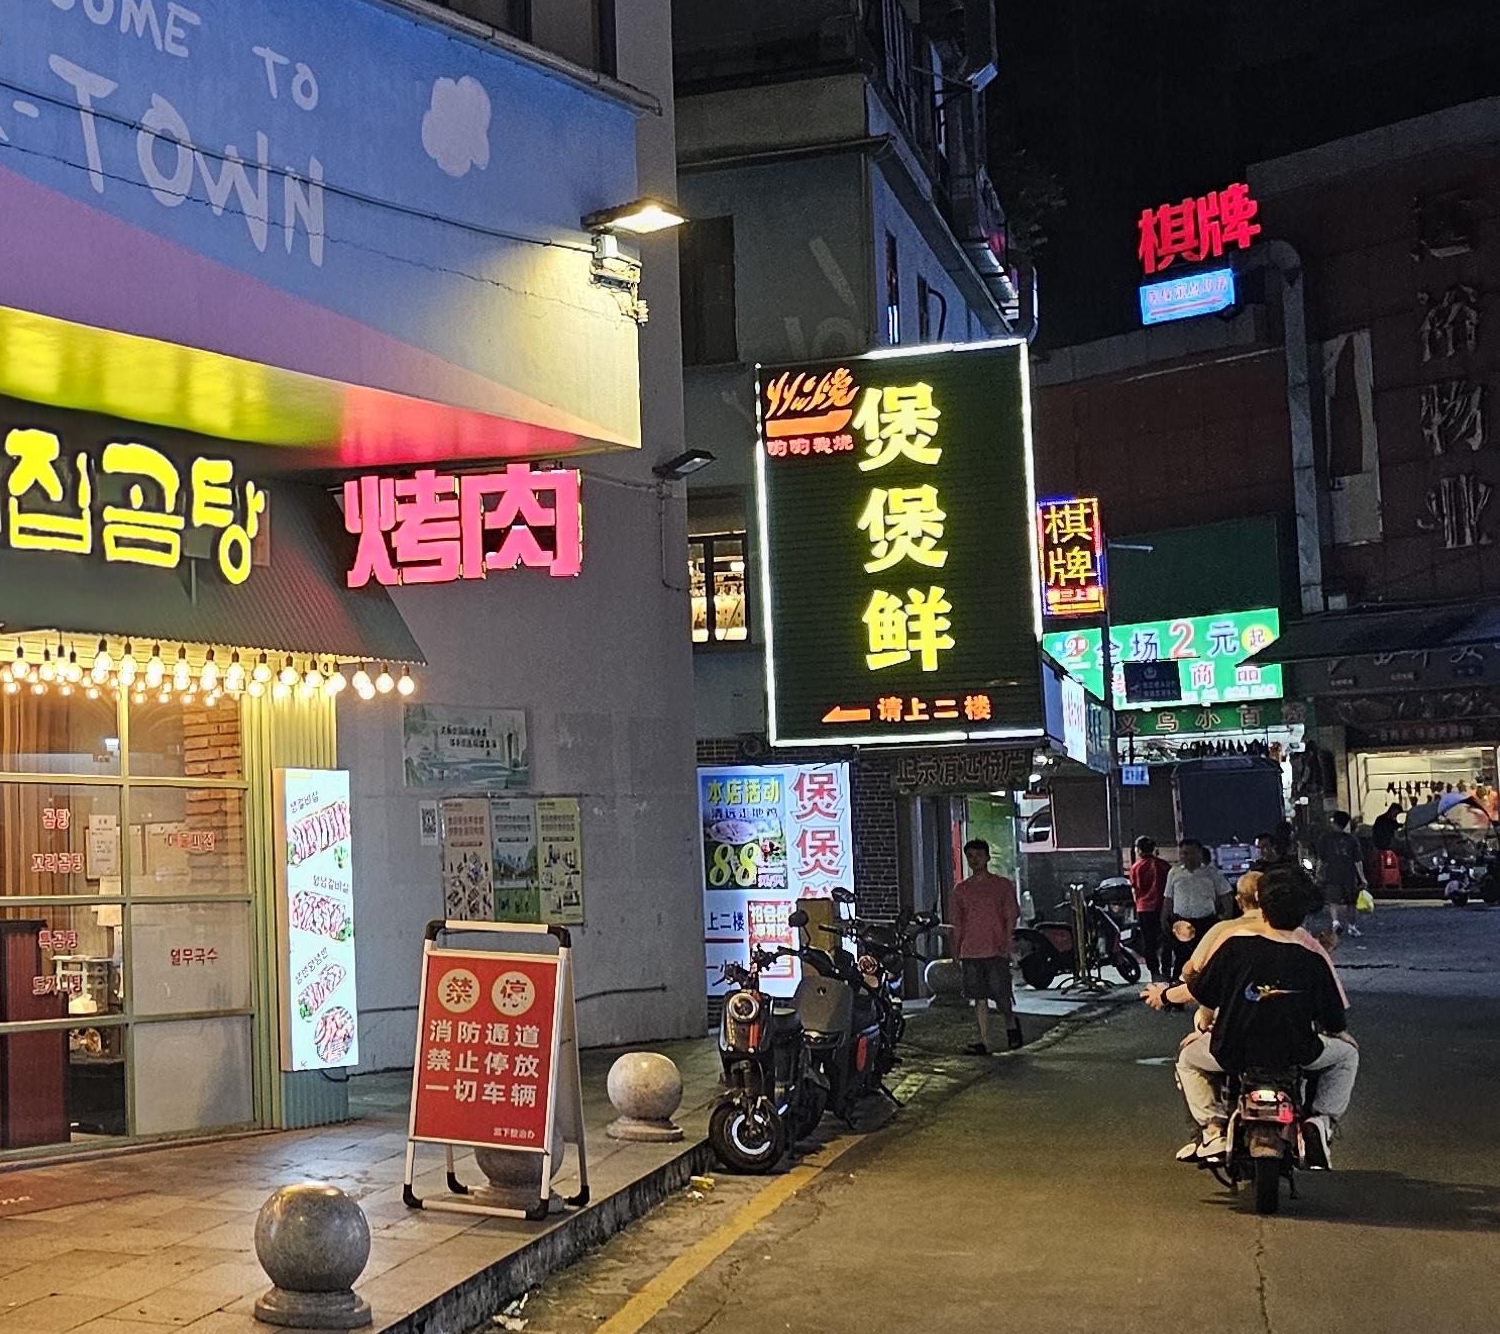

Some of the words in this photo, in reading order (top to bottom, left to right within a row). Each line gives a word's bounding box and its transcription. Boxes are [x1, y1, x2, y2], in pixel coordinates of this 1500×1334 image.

[252, 45, 320, 111] TO
[1138, 182, 1261, 274] 棋牌
[344, 463, 582, 587] 烤肉
[852, 382, 956, 672] 煲煲鲜
[1044, 502, 1097, 586] 棋牌
[877, 694, 991, 722] 请上二楼
[707, 777, 781, 806] 本店活动
[42, 808, 70, 829] 곰탕
[793, 772, 841, 898] 煲煲
[31, 852, 84, 874] 꼬리곰탕
[707, 911, 745, 932] 上二楼
[170, 947, 219, 966] 열무국수
[446, 976, 473, 1004] 禁
[500, 978, 528, 1008] 停
[429, 1019, 540, 1048] 消防通道
[427, 1048, 540, 1079] 禁止停放
[426, 1078, 537, 1108] 一切车辆
